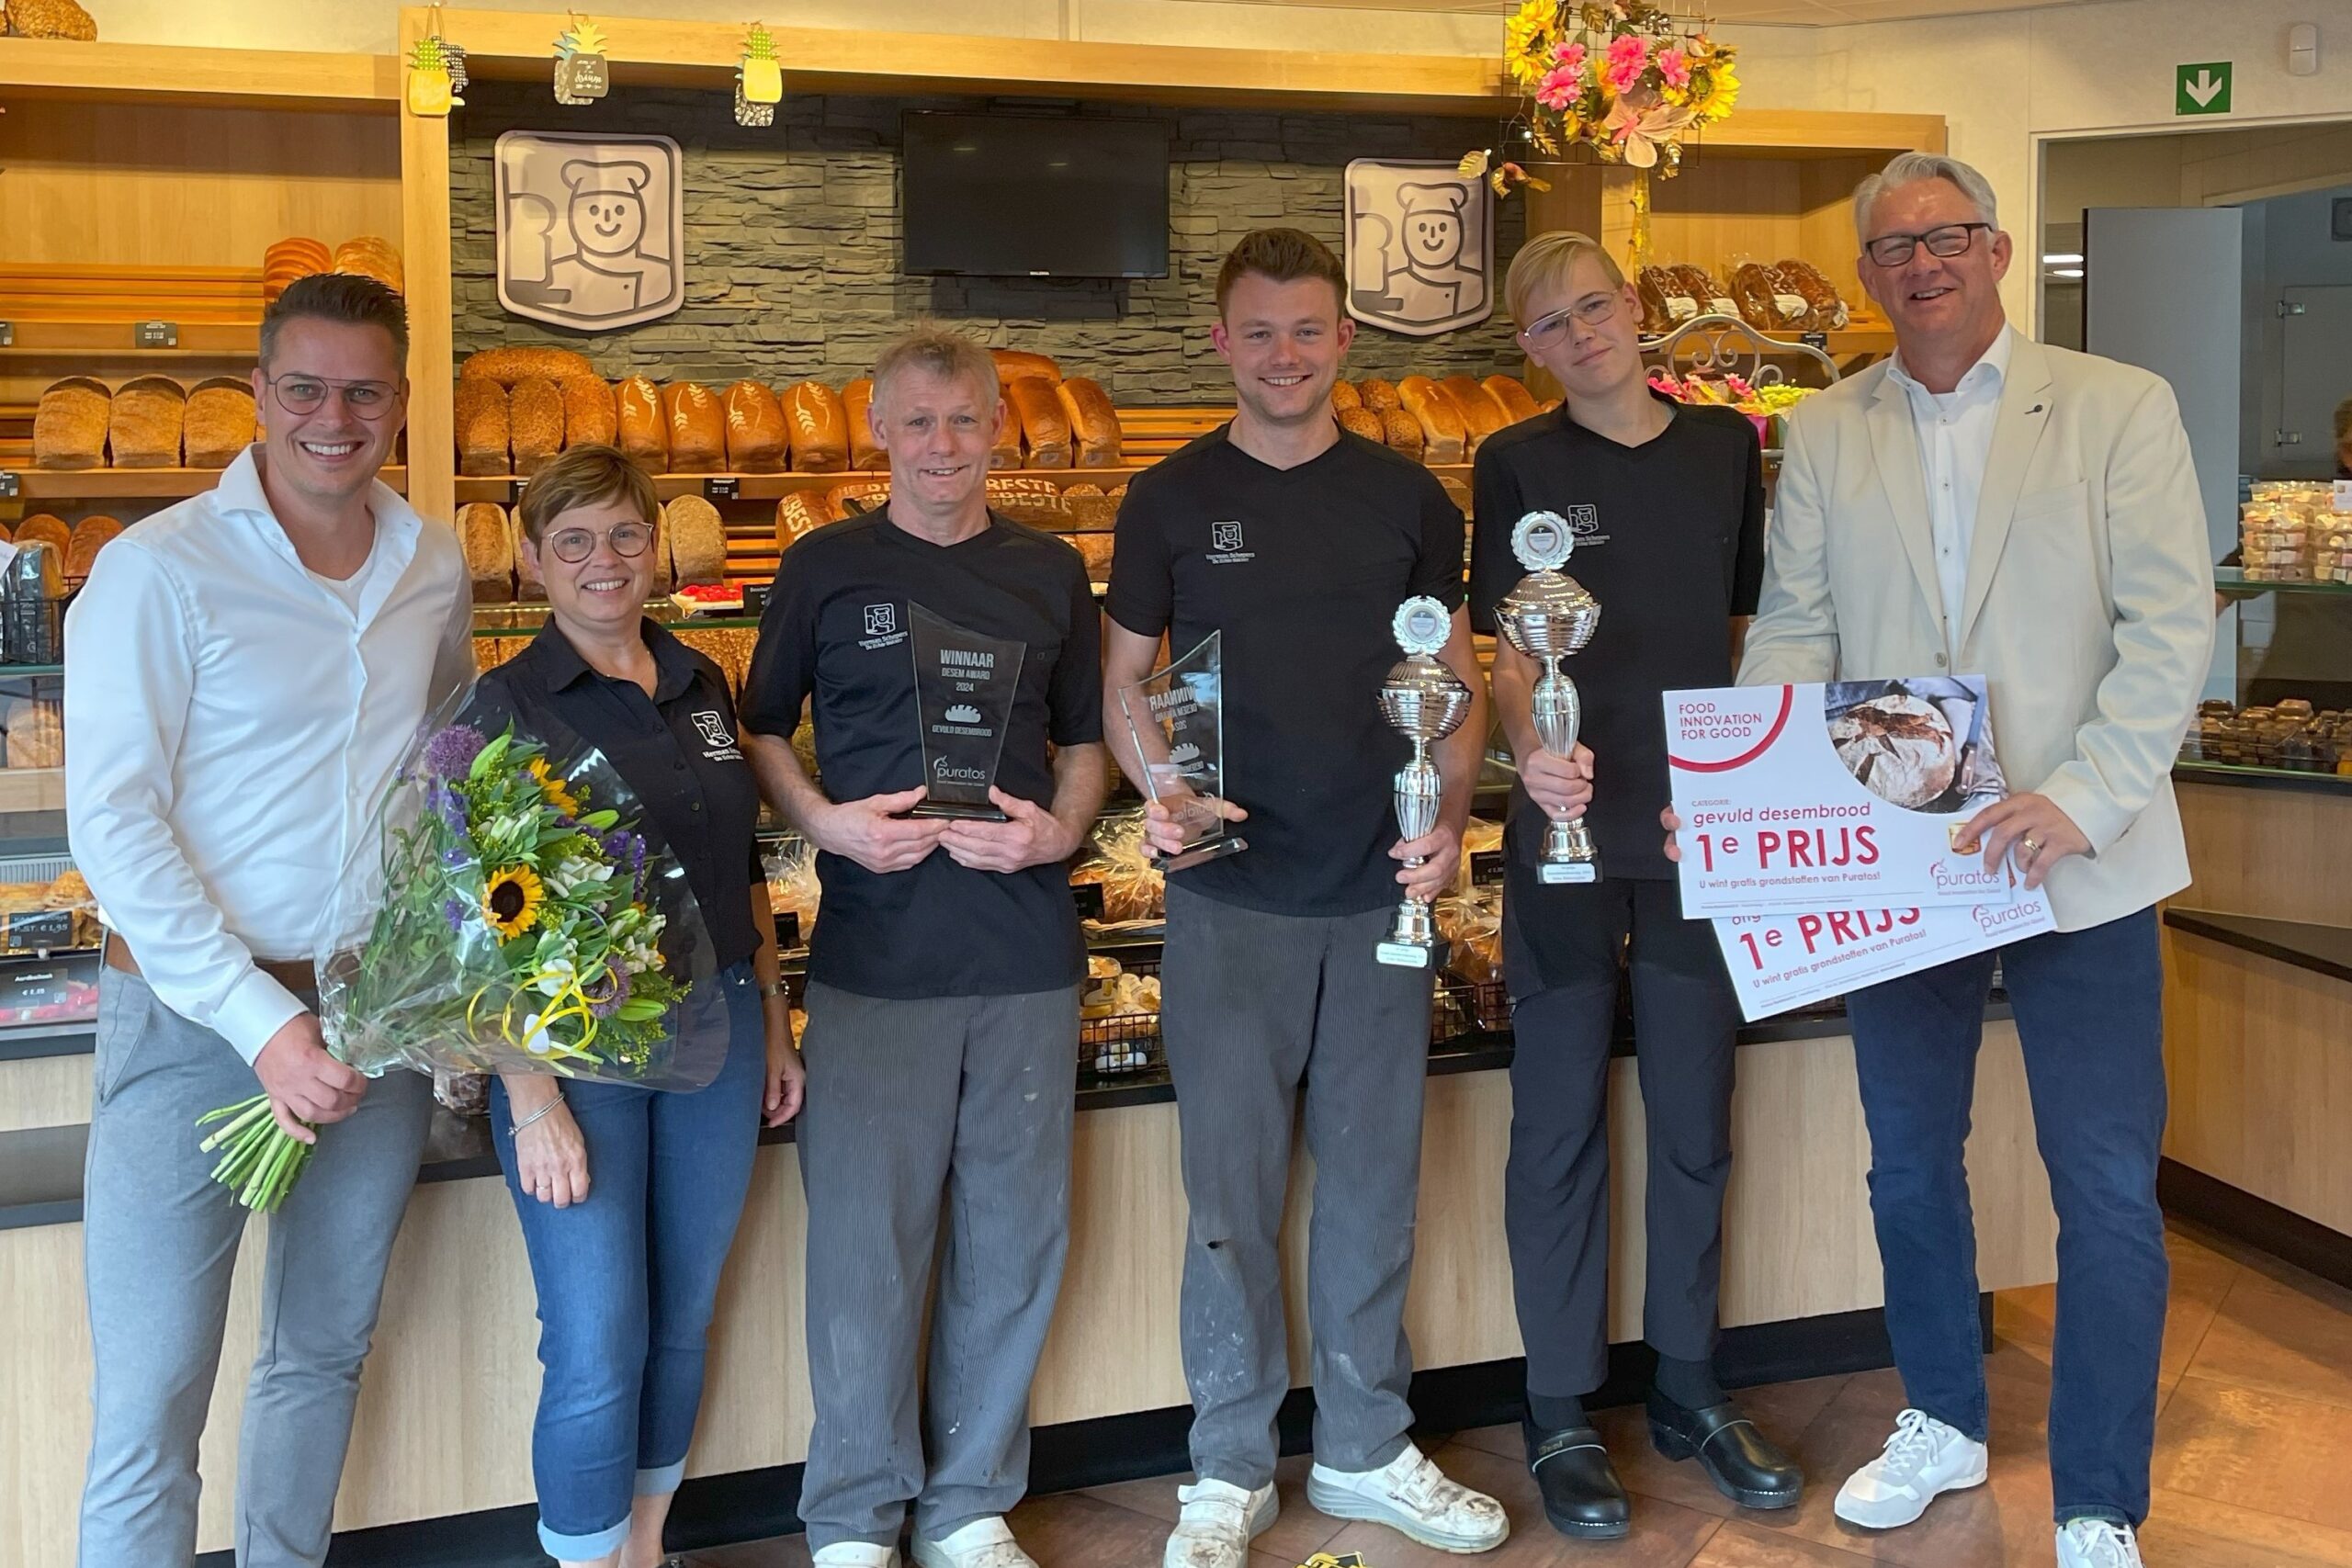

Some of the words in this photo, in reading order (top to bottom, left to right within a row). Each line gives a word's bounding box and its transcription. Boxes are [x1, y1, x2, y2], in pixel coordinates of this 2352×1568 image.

[940, 649, 994, 669] WINNAAR
[942, 668, 965, 679] DESEM
[966, 670, 990, 681] AWARD
[956, 682, 974, 693] 2024
[1679, 703, 1716, 715] FOOD
[1680, 713, 1762, 728] INNOVATION
[1681, 729, 1706, 740] FOR
[1710, 727, 1752, 739] GOOD
[937, 767, 986, 780] puratos
[1693, 807, 1753, 828] gevuld
[1758, 802, 1871, 822] desembrood
[1757, 825, 1880, 869] PRIJS
[1700, 880, 1706, 889] U
[1708, 879, 1728, 888] wint
[1730, 877, 1757, 889] gratis
[1759, 875, 1819, 887] grondstoffen
[1822, 874, 1840, 883] van
[1842, 872, 1881, 882] Puratos!
[1936, 870, 2000, 889] puratos
[1980, 901, 2041, 932] puratos
[1753, 979, 1760, 988] U
[1762, 973, 1781, 986] wint
[1783, 965, 1809, 981] gratis
[1810, 947, 1869, 973] grondstoffen
[1871, 942, 1889, 953] van
[1890, 929, 1928, 947] Puratos!
